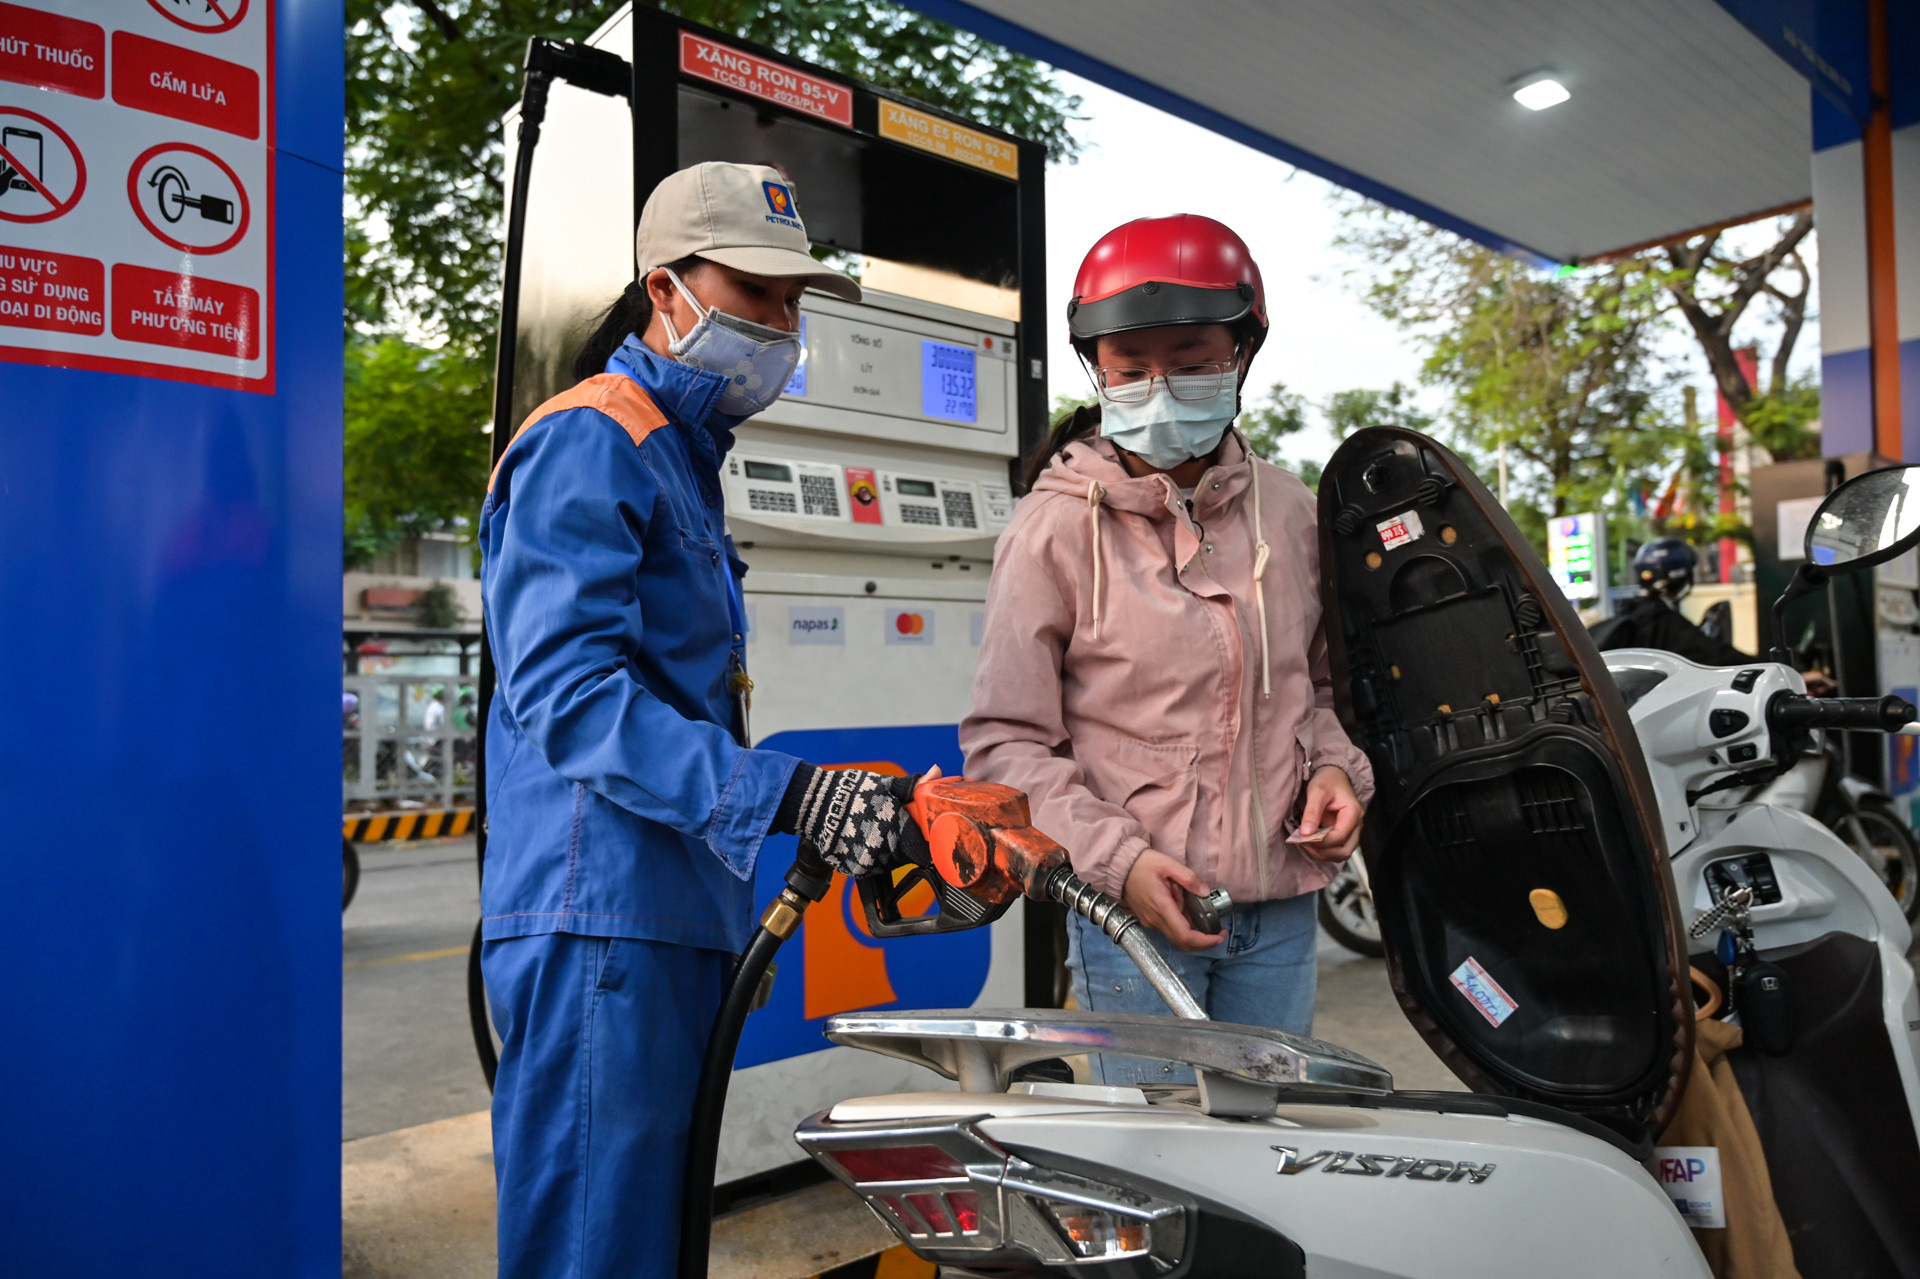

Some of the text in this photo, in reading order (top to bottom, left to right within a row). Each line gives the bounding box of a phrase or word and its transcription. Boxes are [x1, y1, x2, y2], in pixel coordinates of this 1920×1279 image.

[34, 44, 94, 71] THUỐC
[150, 71, 227, 106] CẤM LỬA
[696, 44, 839, 105] XĂNG RON 95-V
[712, 67, 746, 88] TCCS
[750, 80, 762, 93] 01
[773, 88, 825, 114] 2023/PLX
[888, 108, 929, 133] XĂNG
[953, 131, 982, 150] RON
[20, 257, 58, 276] VỰC
[11, 276, 38, 294] SỬ
[44, 283, 89, 301] DỤNG
[153, 286, 225, 316] TẮT MÁY
[35, 304, 51, 319] DI
[56, 305, 102, 326] ĐỘNG
[131, 310, 244, 342] PHƯƠNG TIỆN
[793, 619, 829, 634] napas
[1269, 1144, 1497, 1185] VISION
